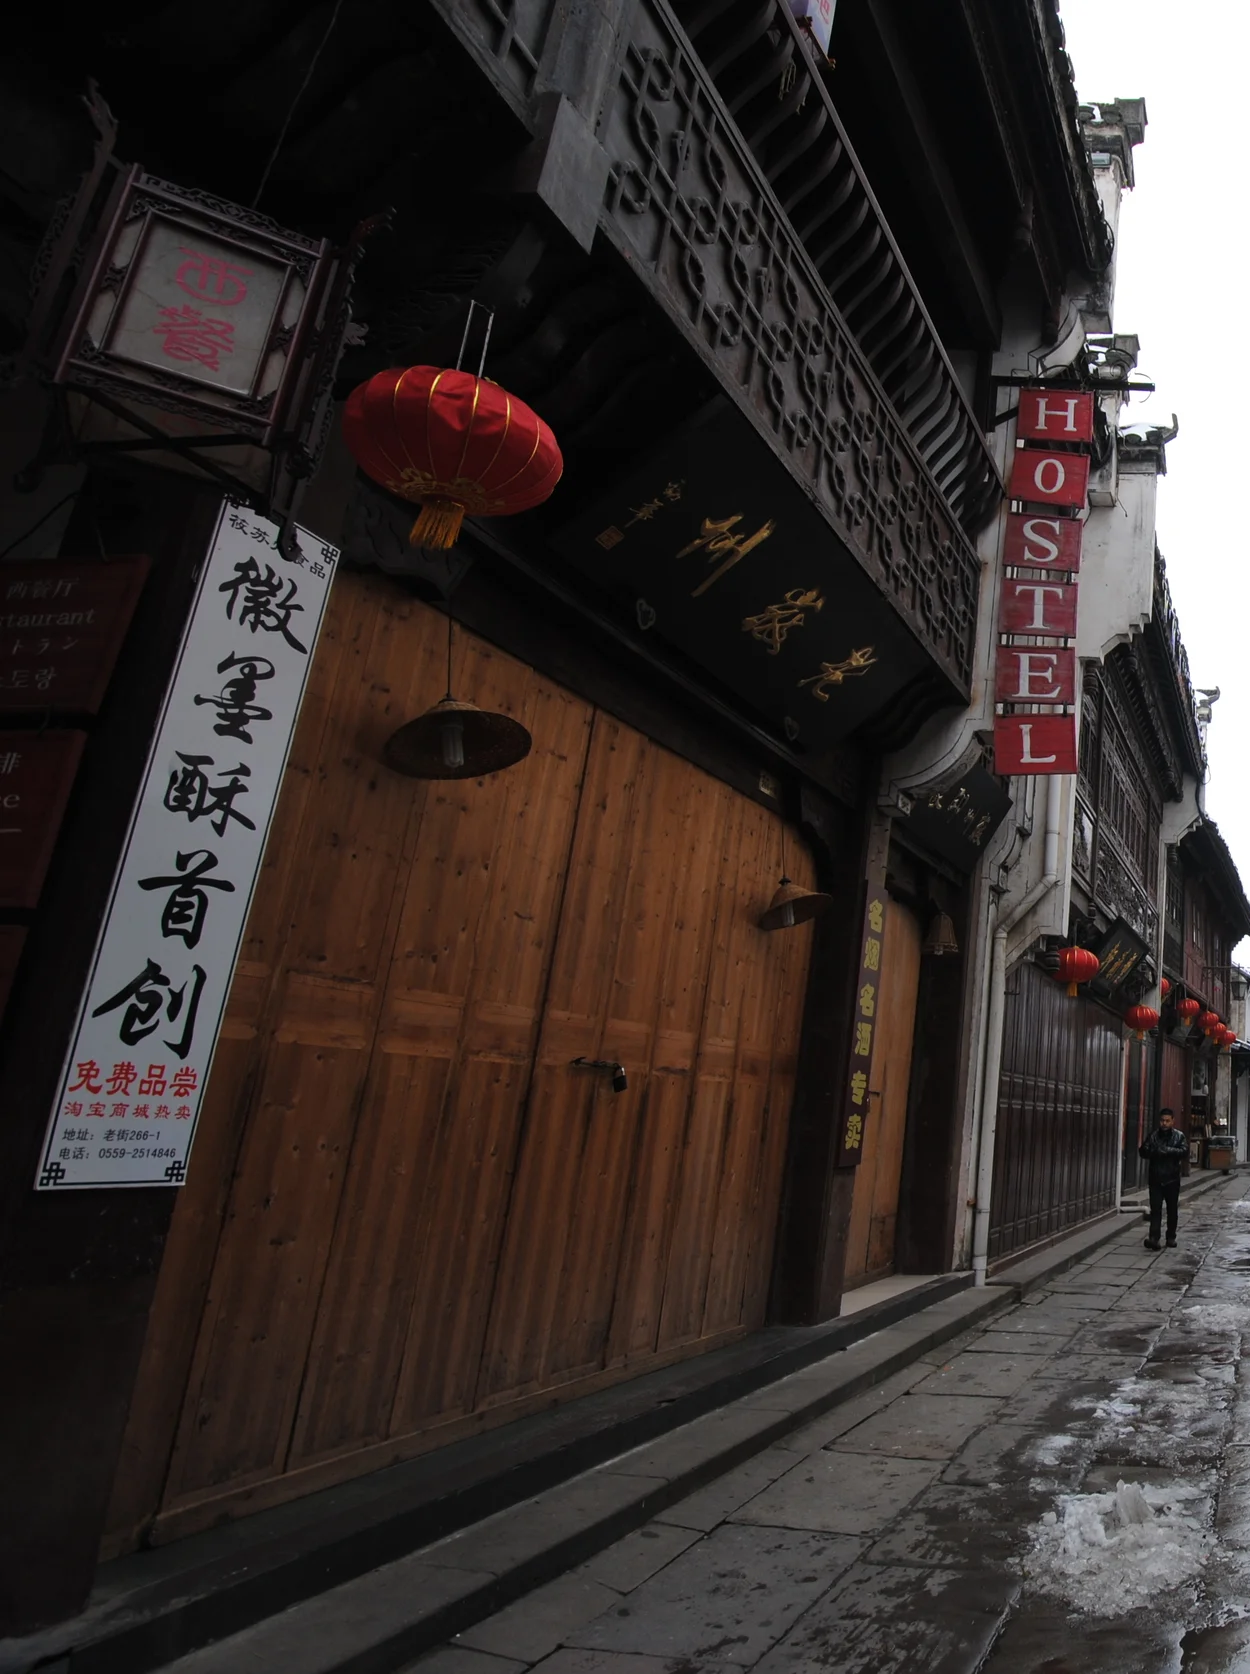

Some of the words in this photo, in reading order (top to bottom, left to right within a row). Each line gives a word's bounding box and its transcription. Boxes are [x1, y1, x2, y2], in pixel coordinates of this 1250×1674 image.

[6, 576, 80, 599] 西餐厅
[1012, 397, 1079, 764] HOSTEL
[92, 556, 308, 1060] 徽墨酥首创
[68, 1060, 198, 1098] 免费品尝
[845, 899, 883, 1150] 名烟名酒专卖
[64, 1101, 191, 1120] 淘宝商城热卖
